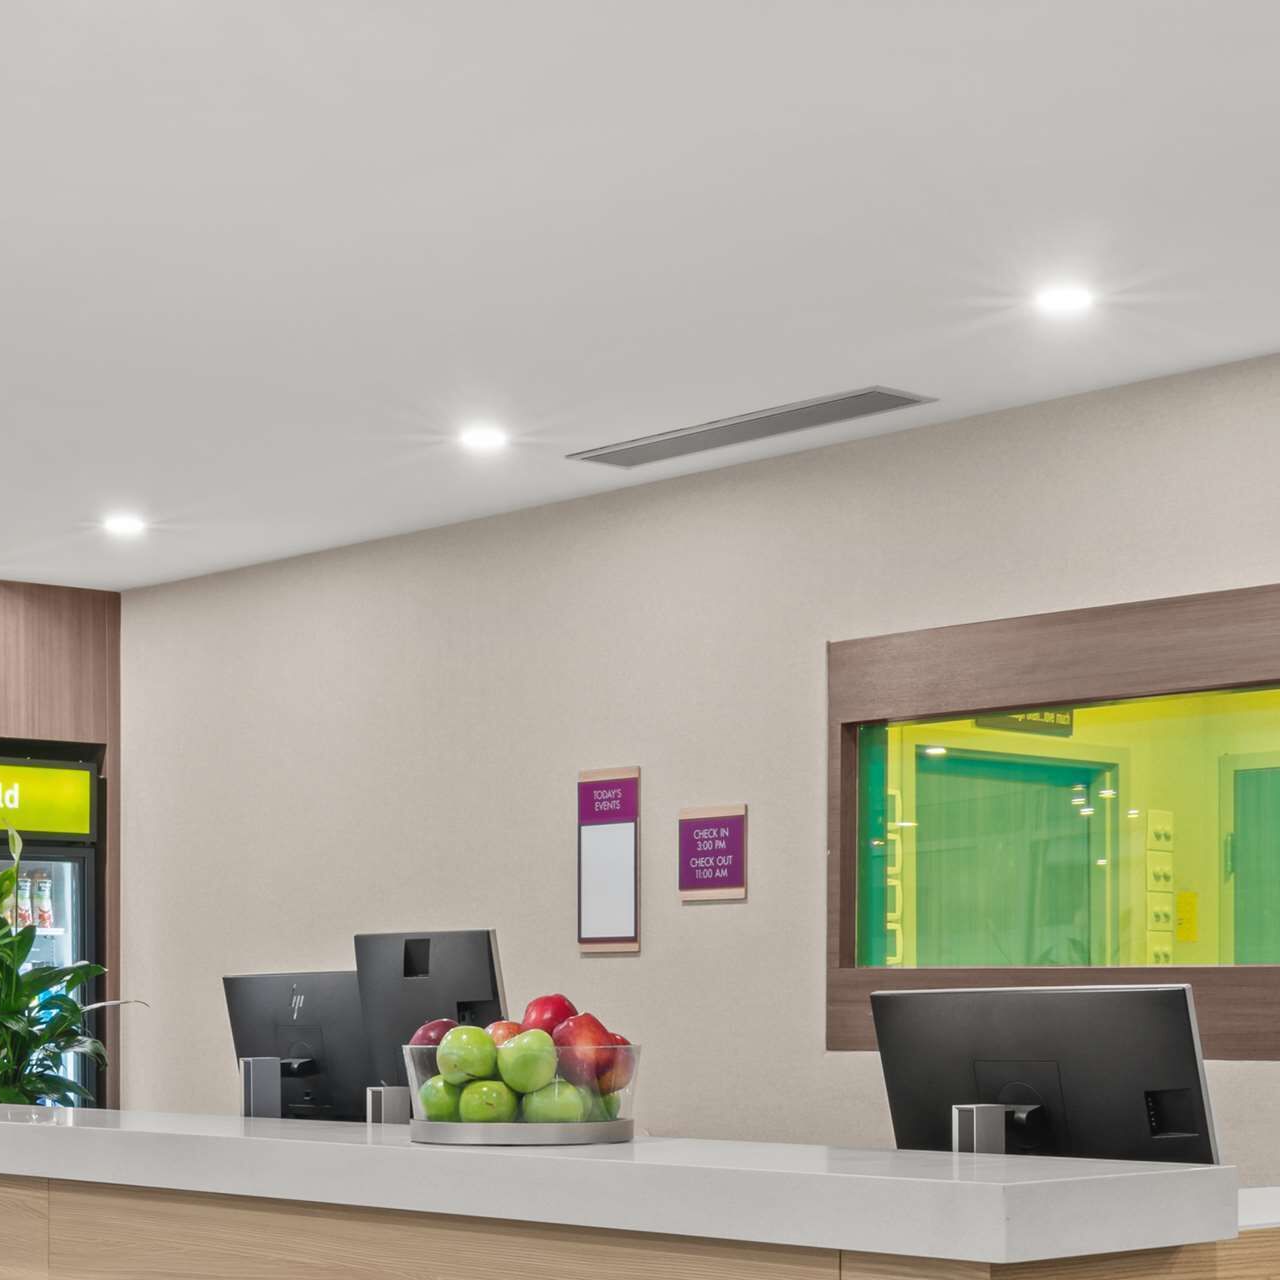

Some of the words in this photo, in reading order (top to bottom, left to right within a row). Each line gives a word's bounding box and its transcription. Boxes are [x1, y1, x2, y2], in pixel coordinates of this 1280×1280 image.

[593, 788, 622, 800] TODAY'S
[595, 800, 621, 812] EVENTS
[693, 828, 718, 840] CHECK
[720, 827, 729, 838] IN
[696, 840, 713, 851] 3:00
[715, 839, 727, 849] PM
[690, 857, 715, 868] CHECK
[716, 855, 733, 866] OUT
[695, 868, 713, 879] 11:00
[715, 868, 728, 878] AM
